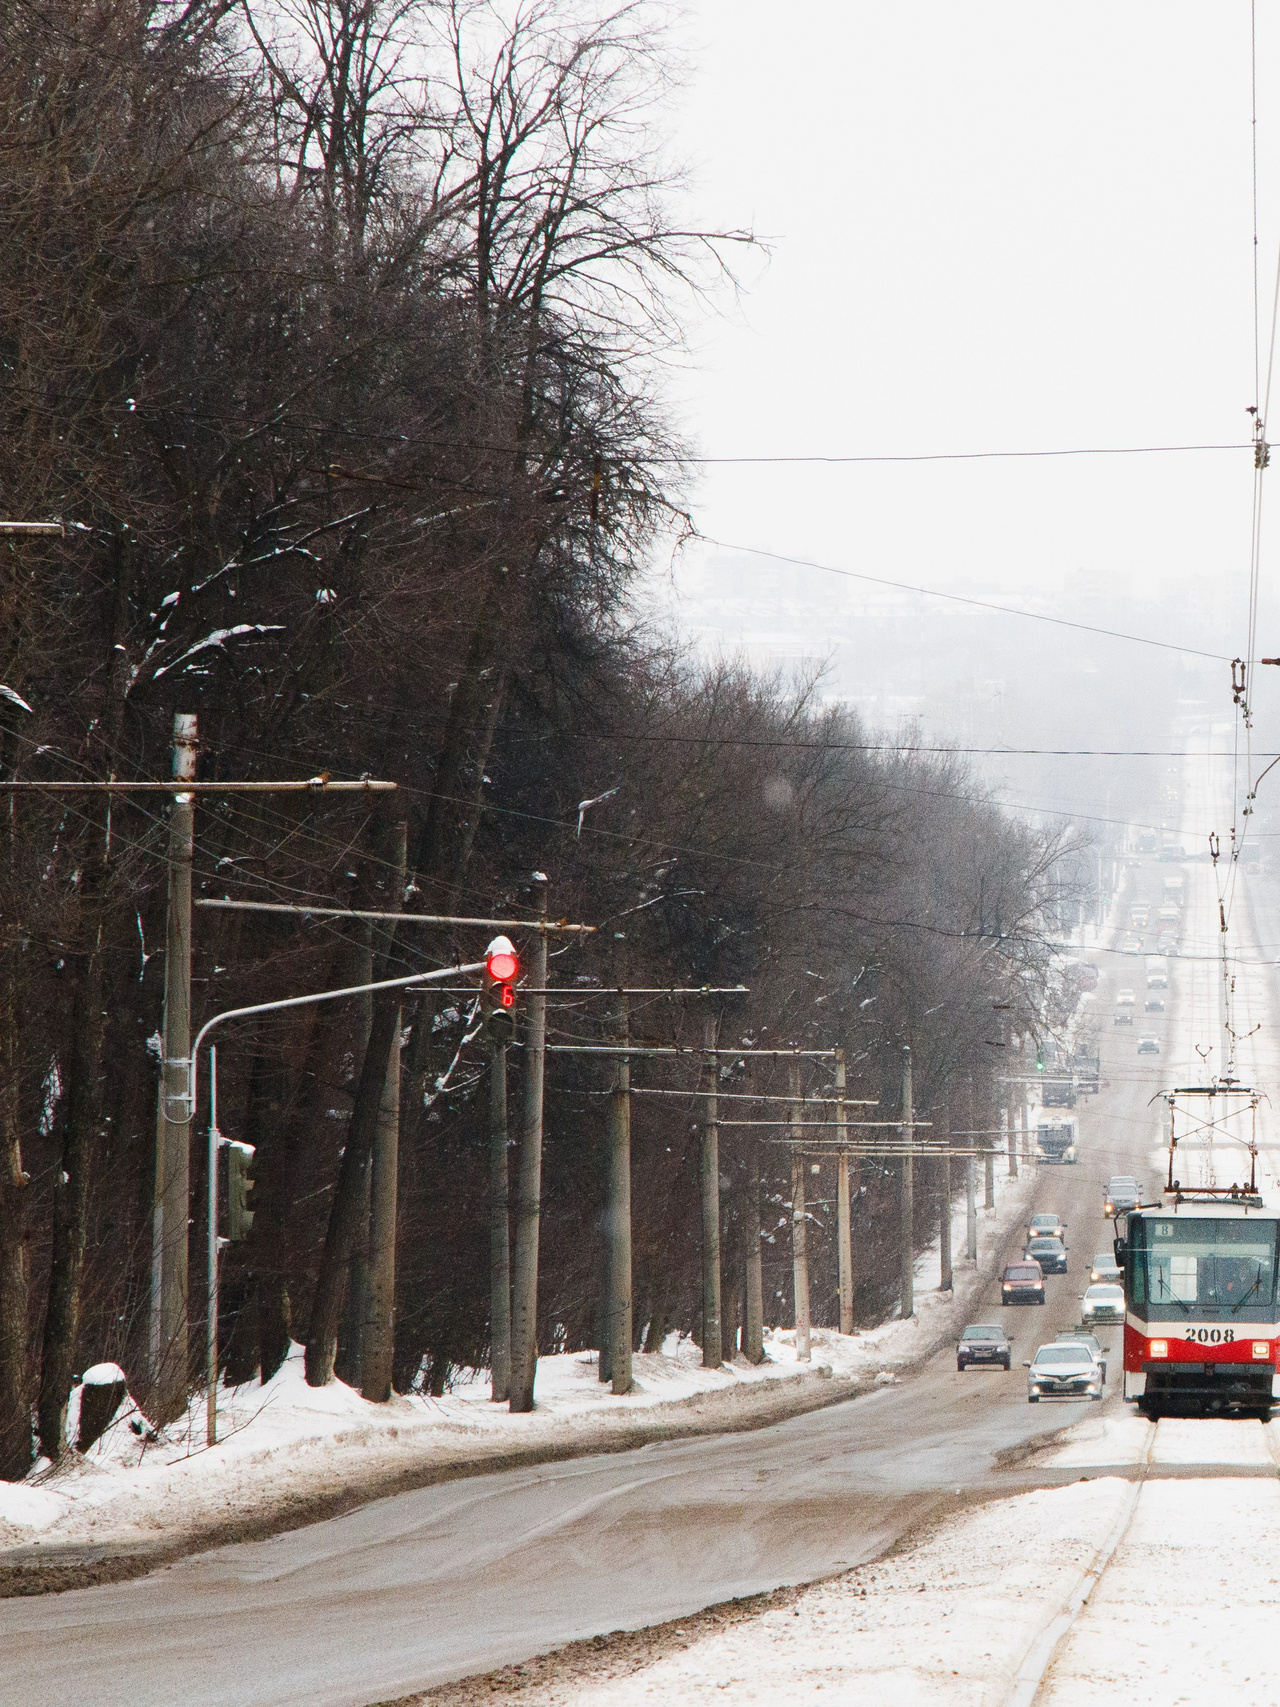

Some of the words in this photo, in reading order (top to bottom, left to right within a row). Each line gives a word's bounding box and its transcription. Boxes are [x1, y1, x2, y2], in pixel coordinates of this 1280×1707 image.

[502, 985, 513, 1007] 6
[1162, 1224, 1168, 1236] 8
[1185, 1328, 1235, 1343] 2008
